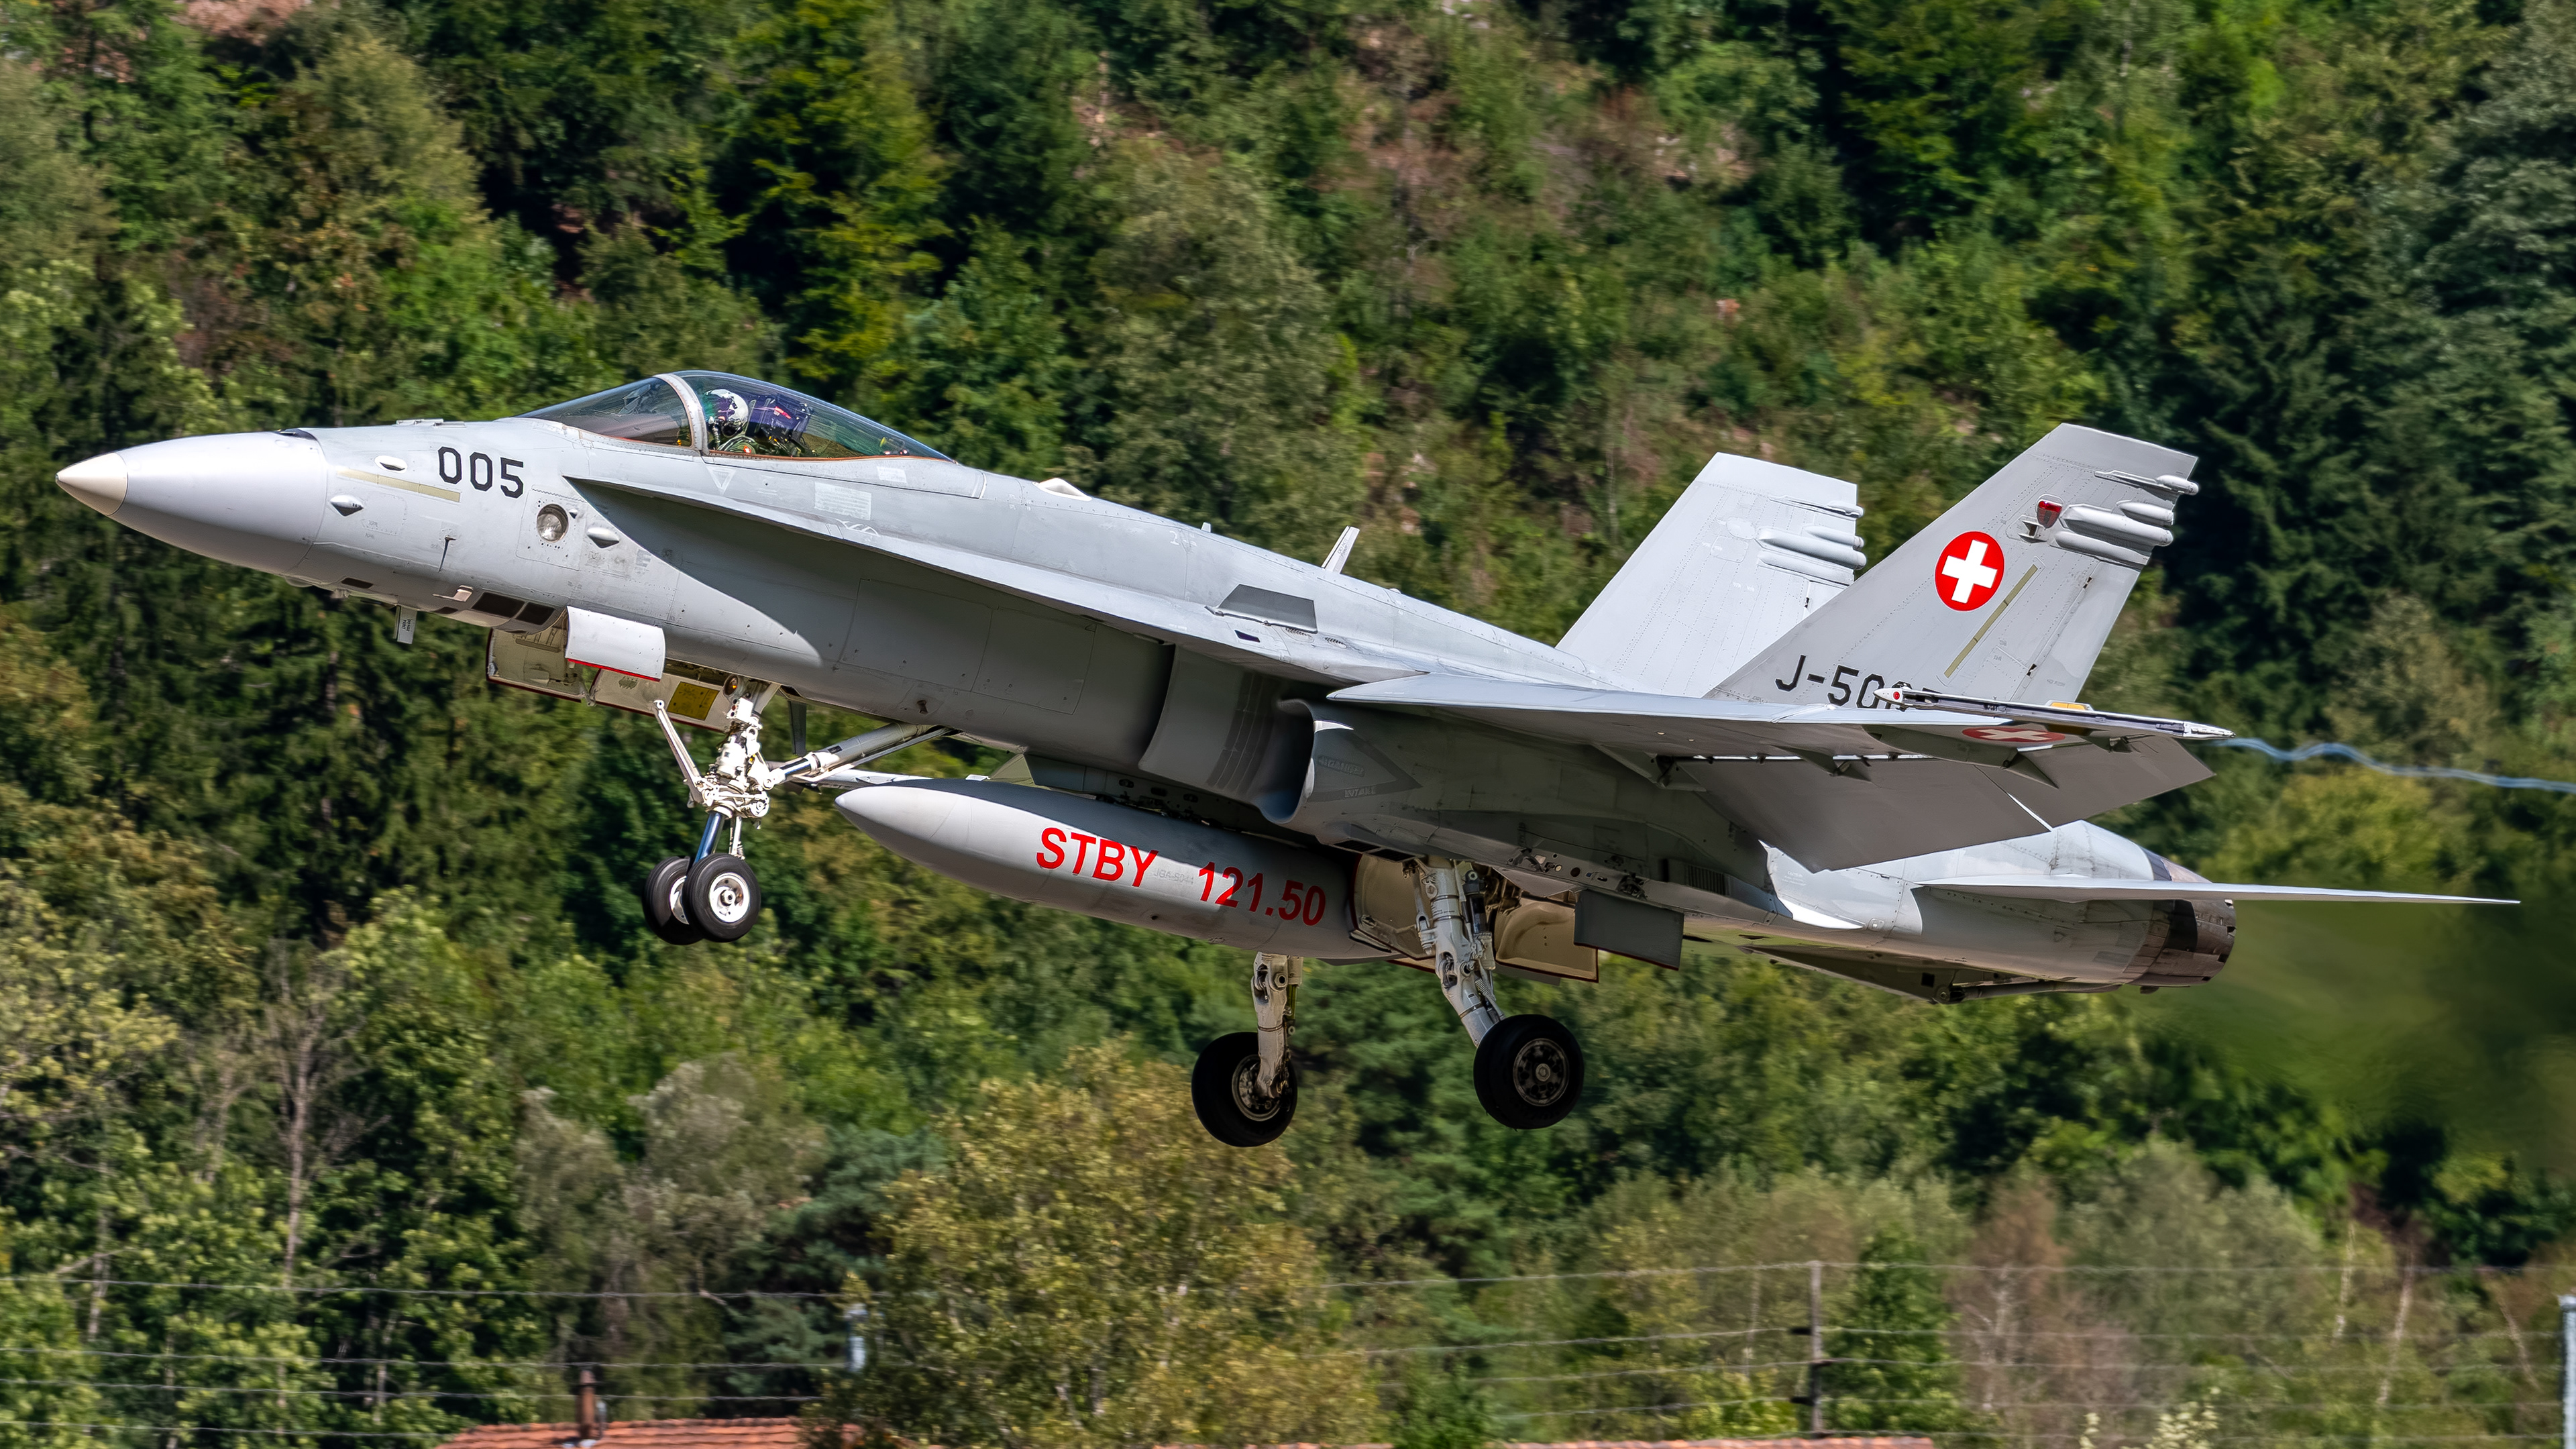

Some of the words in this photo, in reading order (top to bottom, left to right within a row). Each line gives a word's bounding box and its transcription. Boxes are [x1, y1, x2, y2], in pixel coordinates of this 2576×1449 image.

[437, 446, 524, 498] 005
[1774, 655, 1941, 710] J-50
[1036, 827, 1159, 887] STBY
[1198, 861, 1326, 926] 121.50
